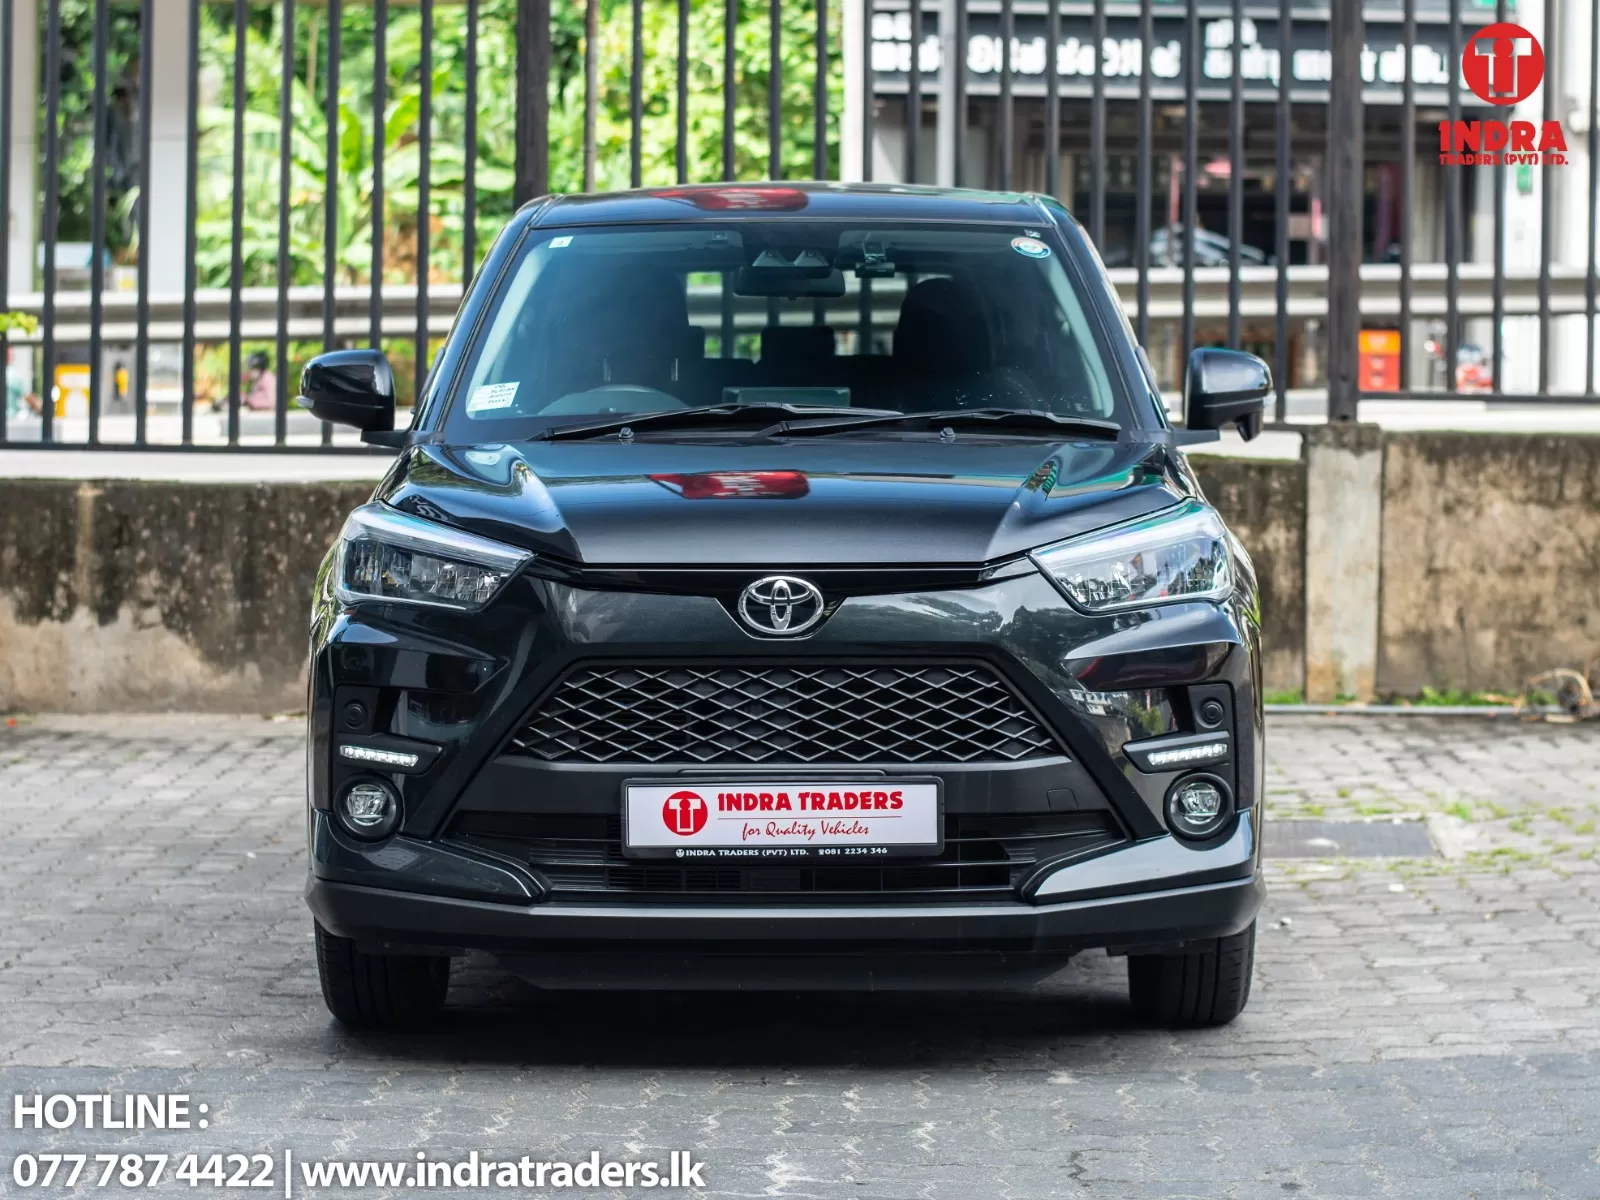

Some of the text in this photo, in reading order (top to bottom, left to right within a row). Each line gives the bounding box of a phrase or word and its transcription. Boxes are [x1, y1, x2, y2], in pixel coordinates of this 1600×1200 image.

[717, 790, 904, 812] INDRA TRADERS
[742, 820, 870, 841] for Quality Vehicles
[686, 849, 716, 857] INDRA
[718, 849, 759, 857] TRADERS
[762, 849, 788, 857] (PVT)
[844, 847, 868, 855] 2234
